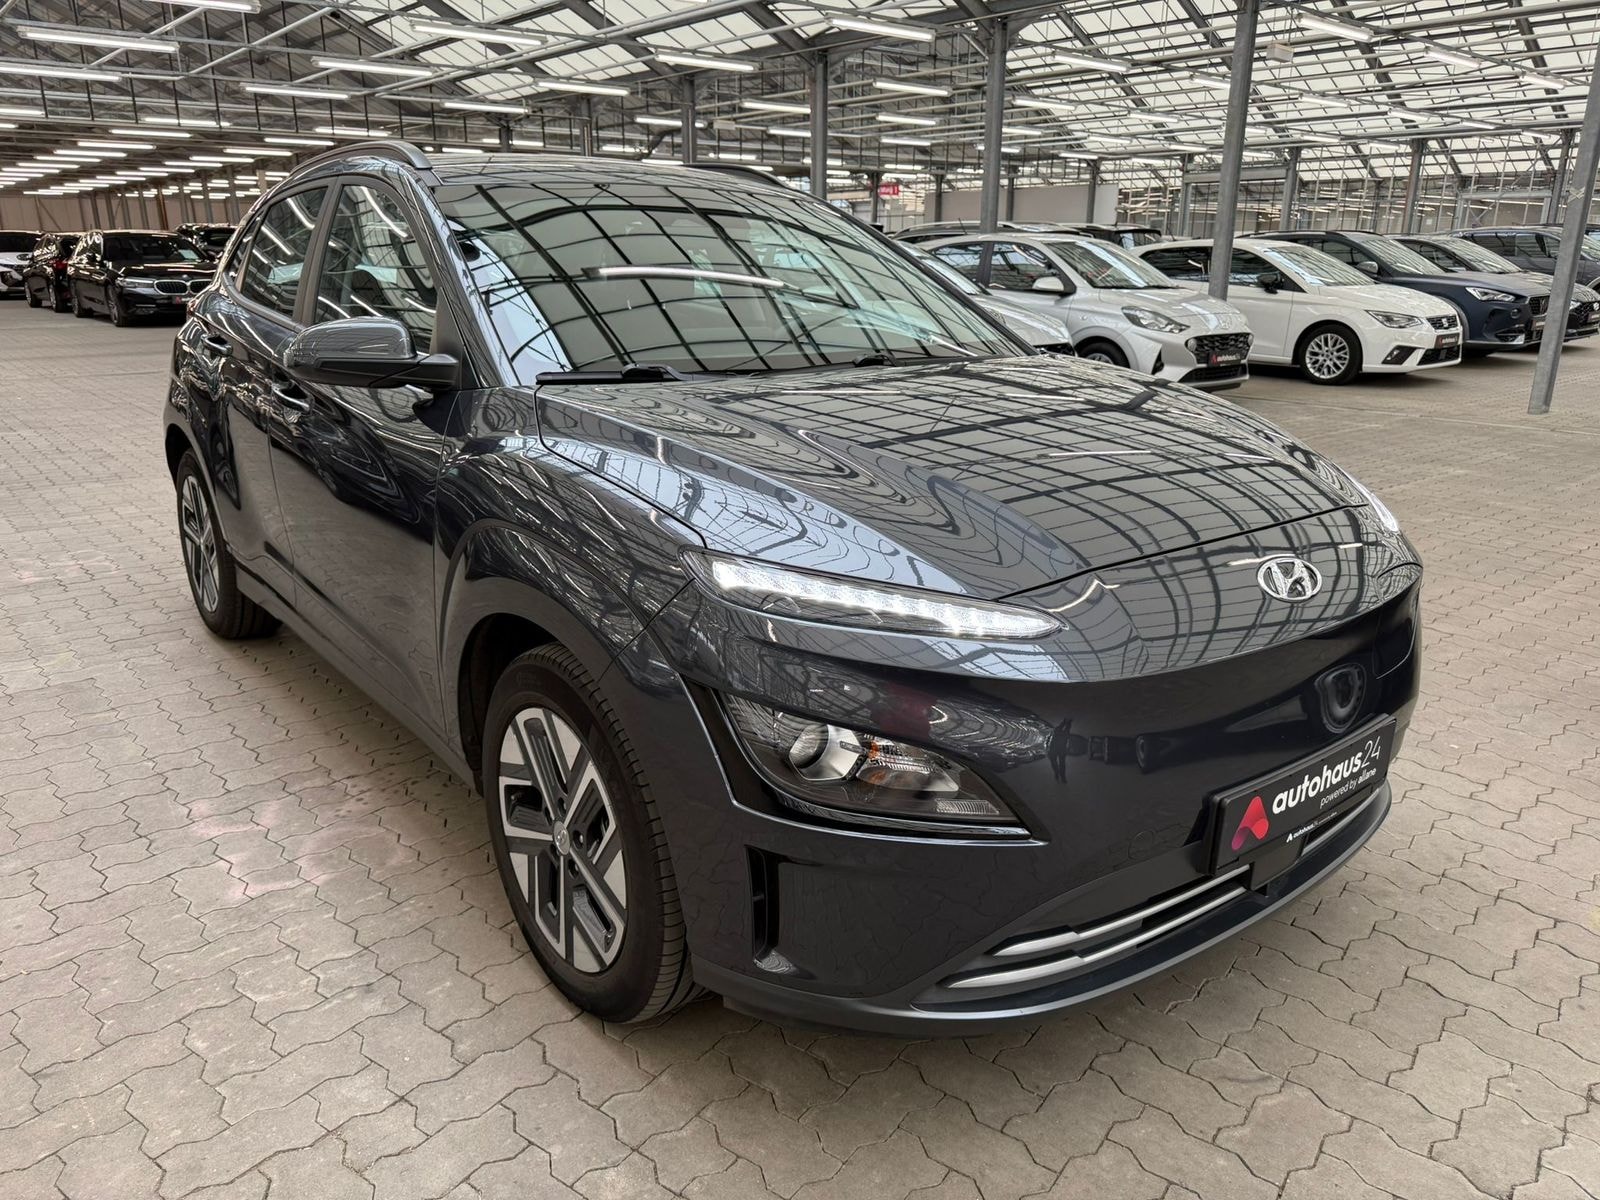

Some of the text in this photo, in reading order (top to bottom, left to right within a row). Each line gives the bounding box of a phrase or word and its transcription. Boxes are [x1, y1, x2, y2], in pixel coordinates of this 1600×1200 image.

[1272, 735, 1381, 815] autohaus24
[1320, 781, 1349, 809] powered
[1349, 778, 1358, 790] by
